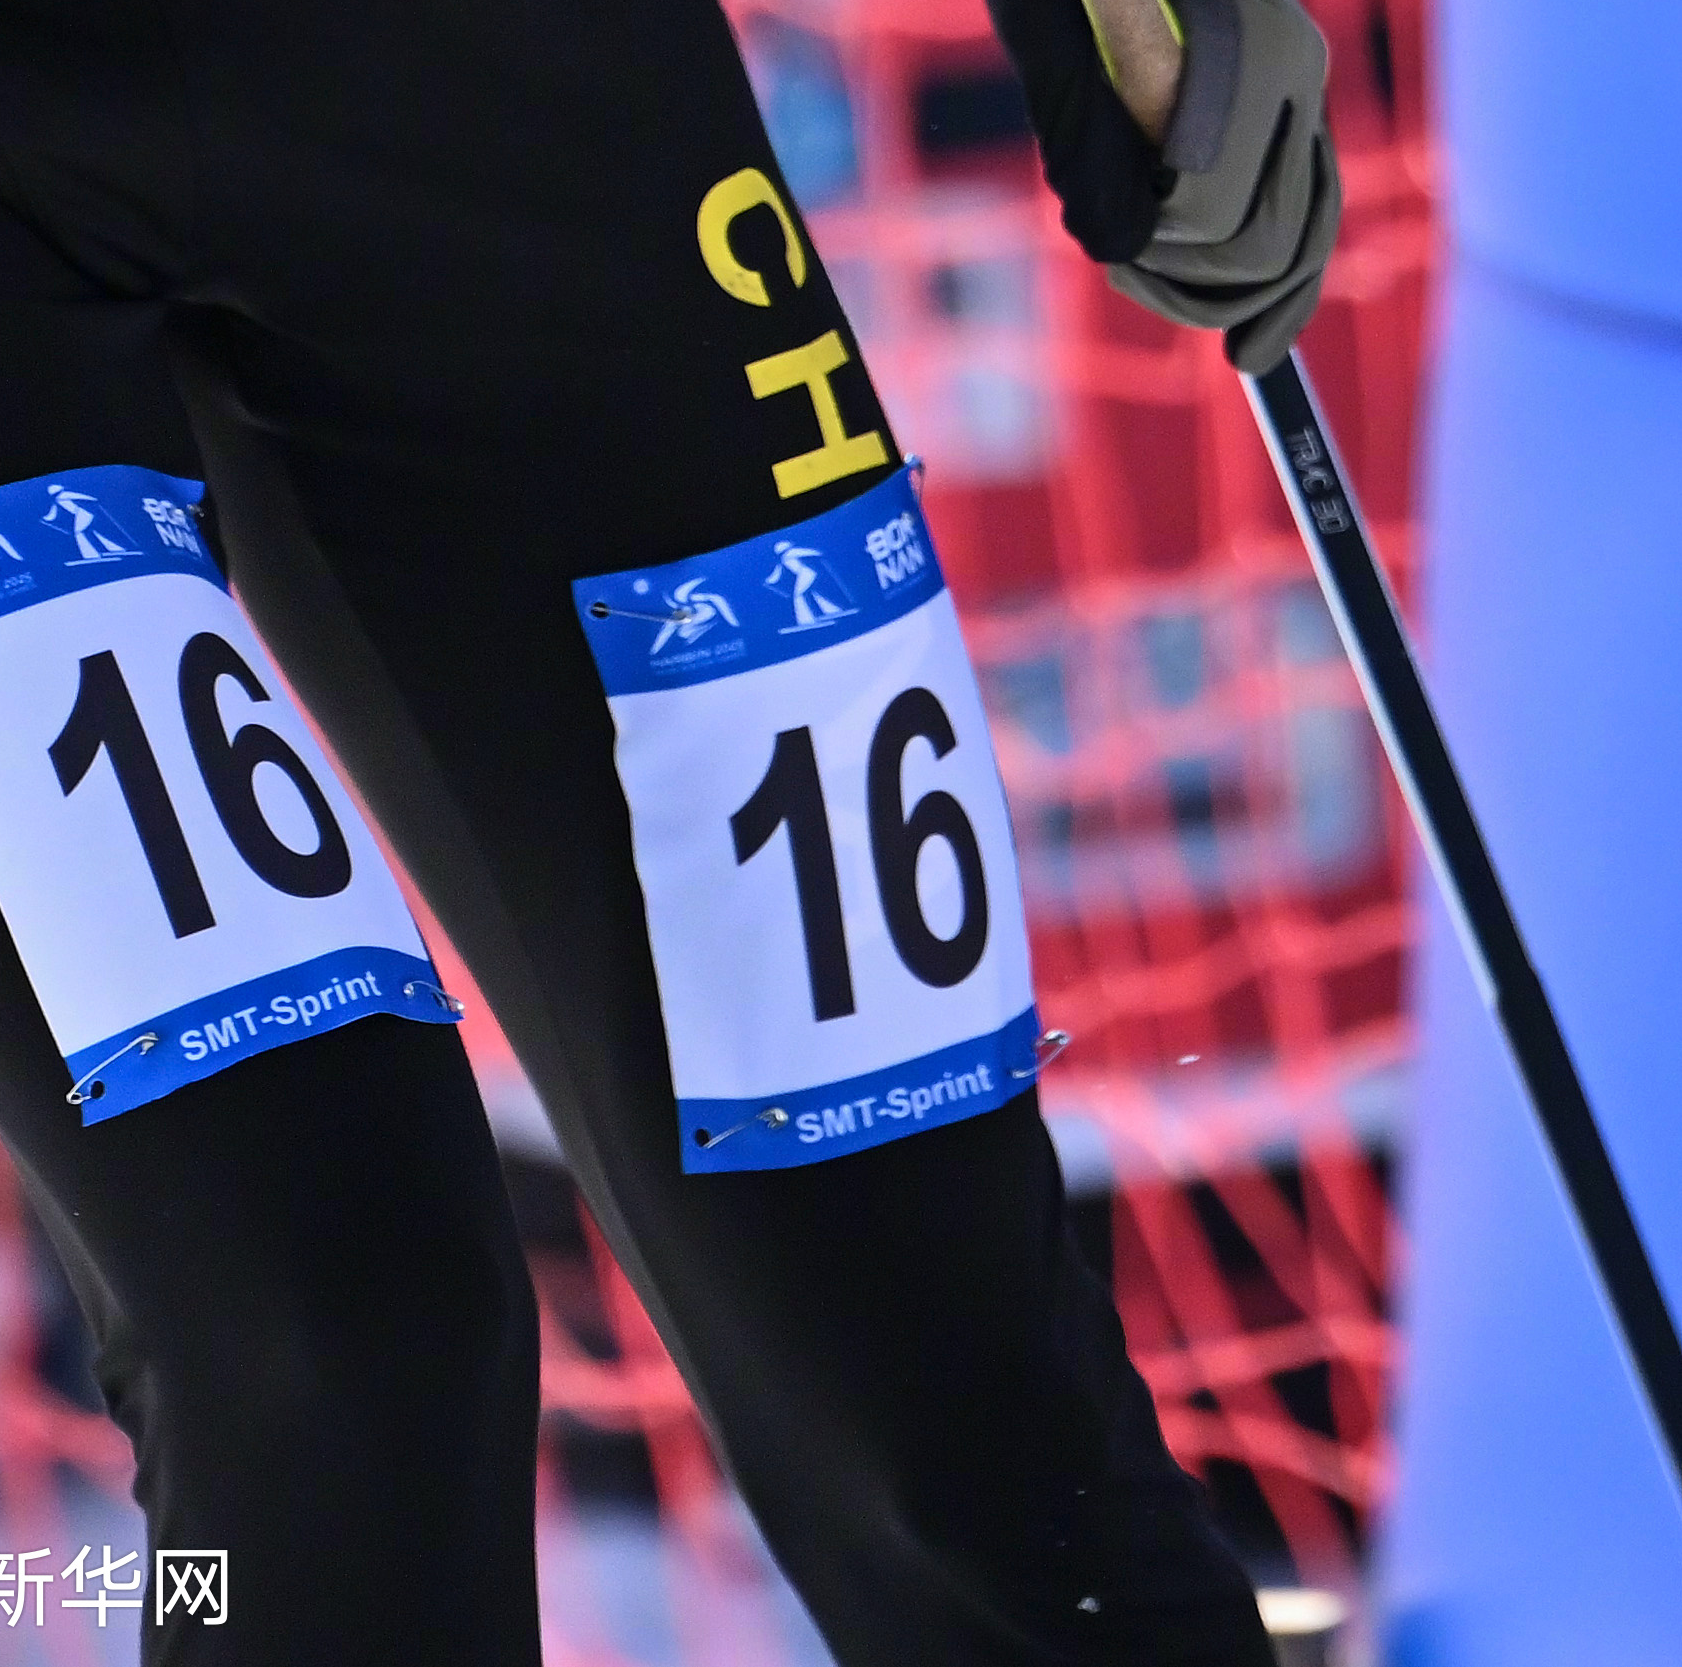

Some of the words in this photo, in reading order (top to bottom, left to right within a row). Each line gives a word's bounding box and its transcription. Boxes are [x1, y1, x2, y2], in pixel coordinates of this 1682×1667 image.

[695, 167, 889, 499] CH
[47, 631, 353, 940] 16
[729, 685, 991, 1023] 16
[179, 970, 383, 1061] SMT-Sprint
[795, 1063, 995, 1144] SMT-Sprint
